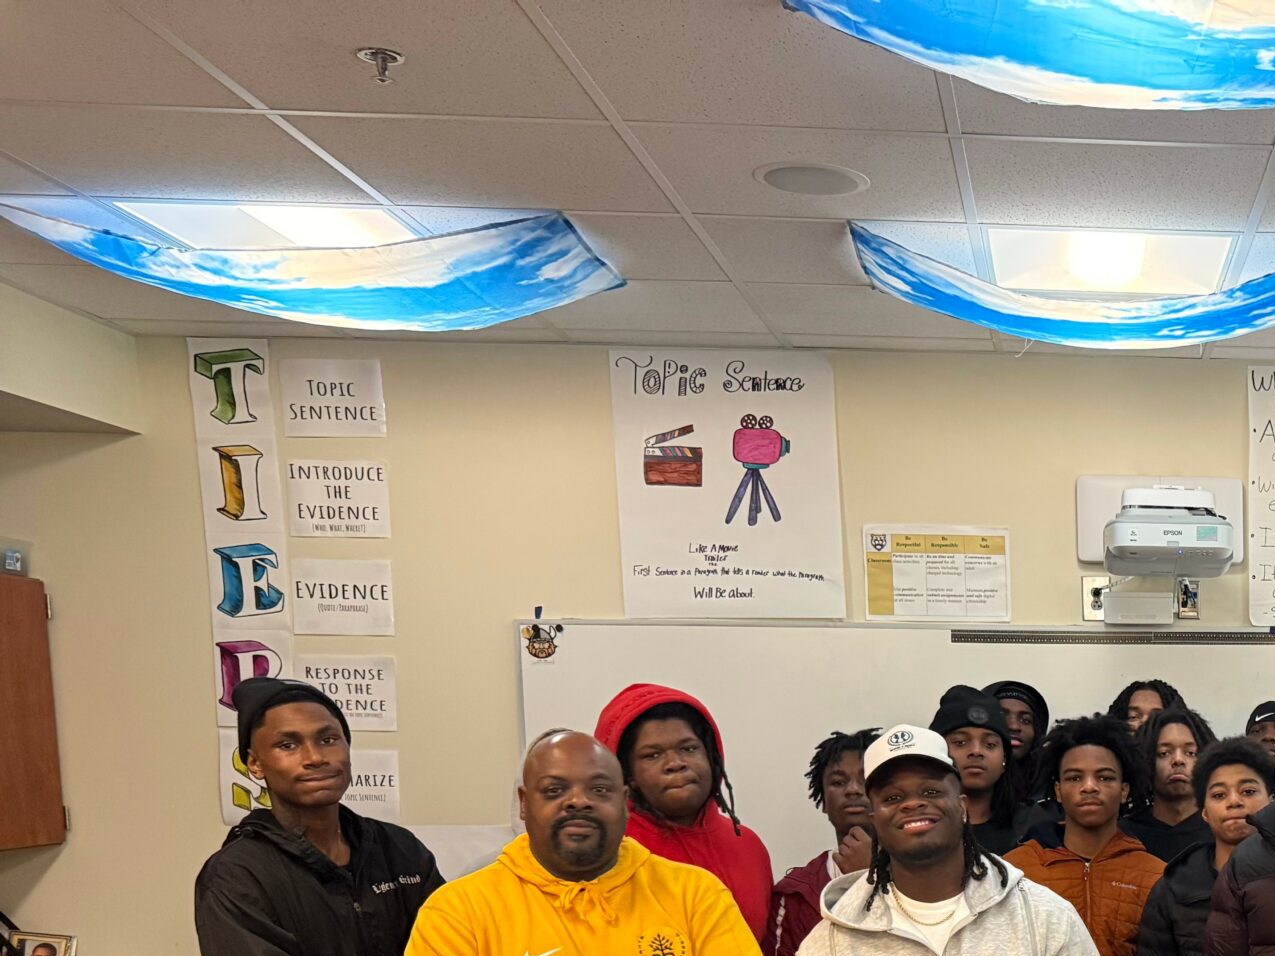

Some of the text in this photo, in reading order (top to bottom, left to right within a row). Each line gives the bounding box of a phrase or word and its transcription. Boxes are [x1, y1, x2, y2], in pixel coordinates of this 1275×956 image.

[723, 360, 805, 393] Sentence
[194, 347, 265, 425] T
[305, 380, 355, 397] TOPIC
[288, 403, 378, 421] SENTENCE
[288, 463, 384, 482] INTRODUCE
[211, 444, 268, 521] I
[323, 484, 352, 500] THE
[297, 503, 379, 521] EVIDENCE
[633, 565, 650, 576] First
[212, 543, 285, 617] E
[295, 581, 389, 601] EVIDENCE
[693, 586, 713, 599] Will
[715, 587, 726, 598] Be
[305, 665, 384, 681] RESPONSE
[345, 682, 373, 695] THE
